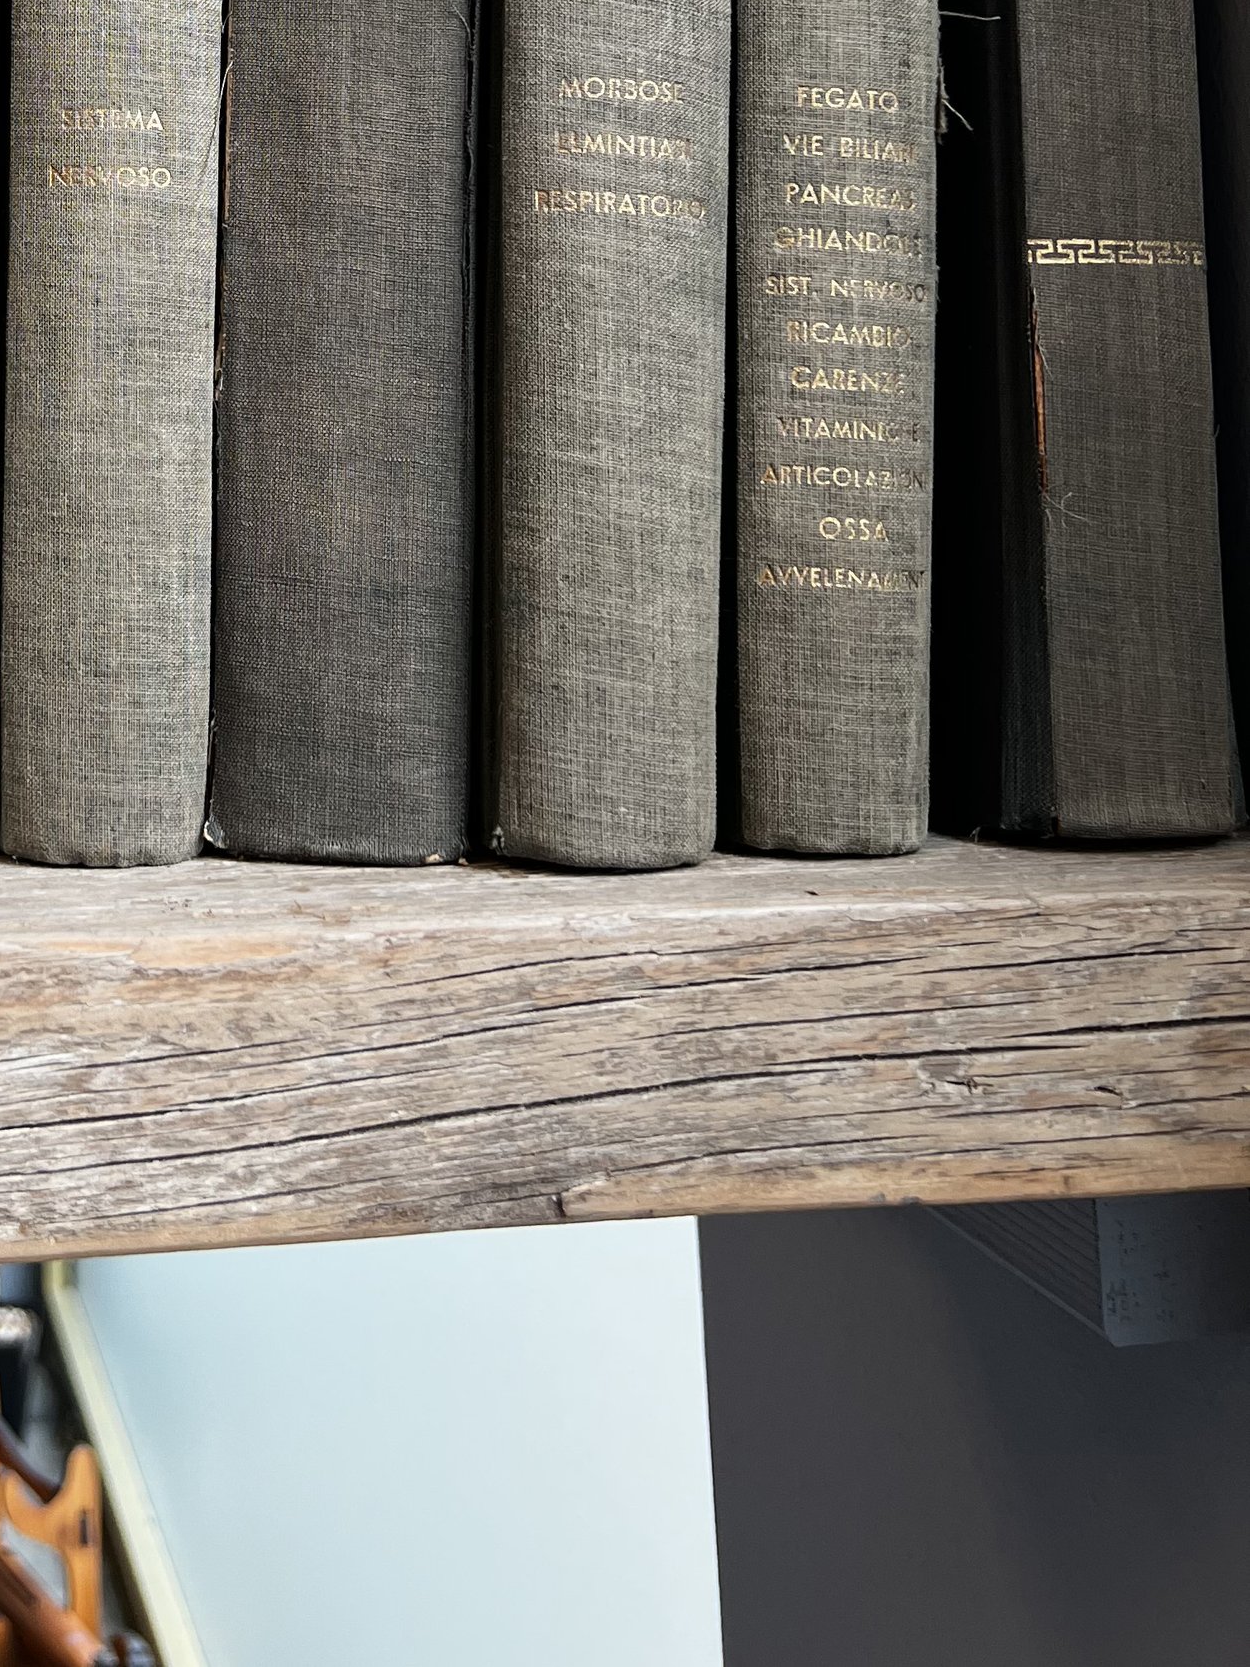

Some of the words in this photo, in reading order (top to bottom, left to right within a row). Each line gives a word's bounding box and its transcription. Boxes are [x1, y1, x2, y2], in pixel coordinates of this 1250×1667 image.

[797, 87, 899, 113] FEGATO
[61, 108, 164, 131] SISTEMA
[783, 134, 823, 156] VIE
[49, 165, 172, 188] NERVOSO
[786, 183, 916, 212] PANCREAS
[787, 321, 913, 348] RICAMBIO
[819, 516, 890, 542] OSSA
